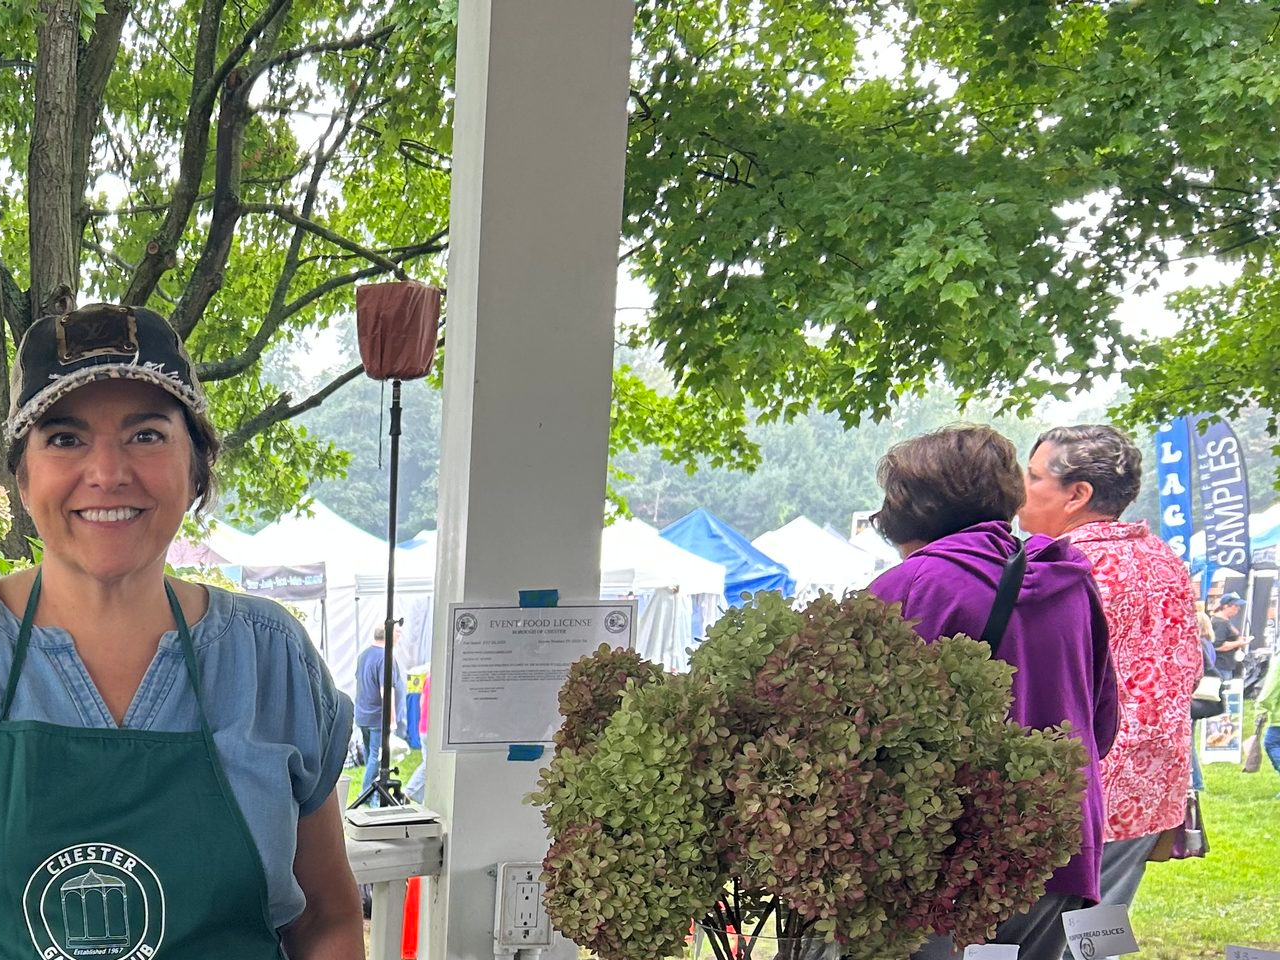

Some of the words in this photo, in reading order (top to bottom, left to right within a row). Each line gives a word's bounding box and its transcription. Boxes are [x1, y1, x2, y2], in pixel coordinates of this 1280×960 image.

[1198, 453, 1211, 491] FREE
[1159, 422, 1187, 557] LAGS
[1207, 436, 1246, 566] SAMPLES
[489, 619, 519, 628] EVENT
[523, 619, 551, 627] FOOD
[554, 618, 592, 627] LICENSE
[46, 846, 137, 875] CHESTER
[1102, 927, 1125, 936] SLICES
